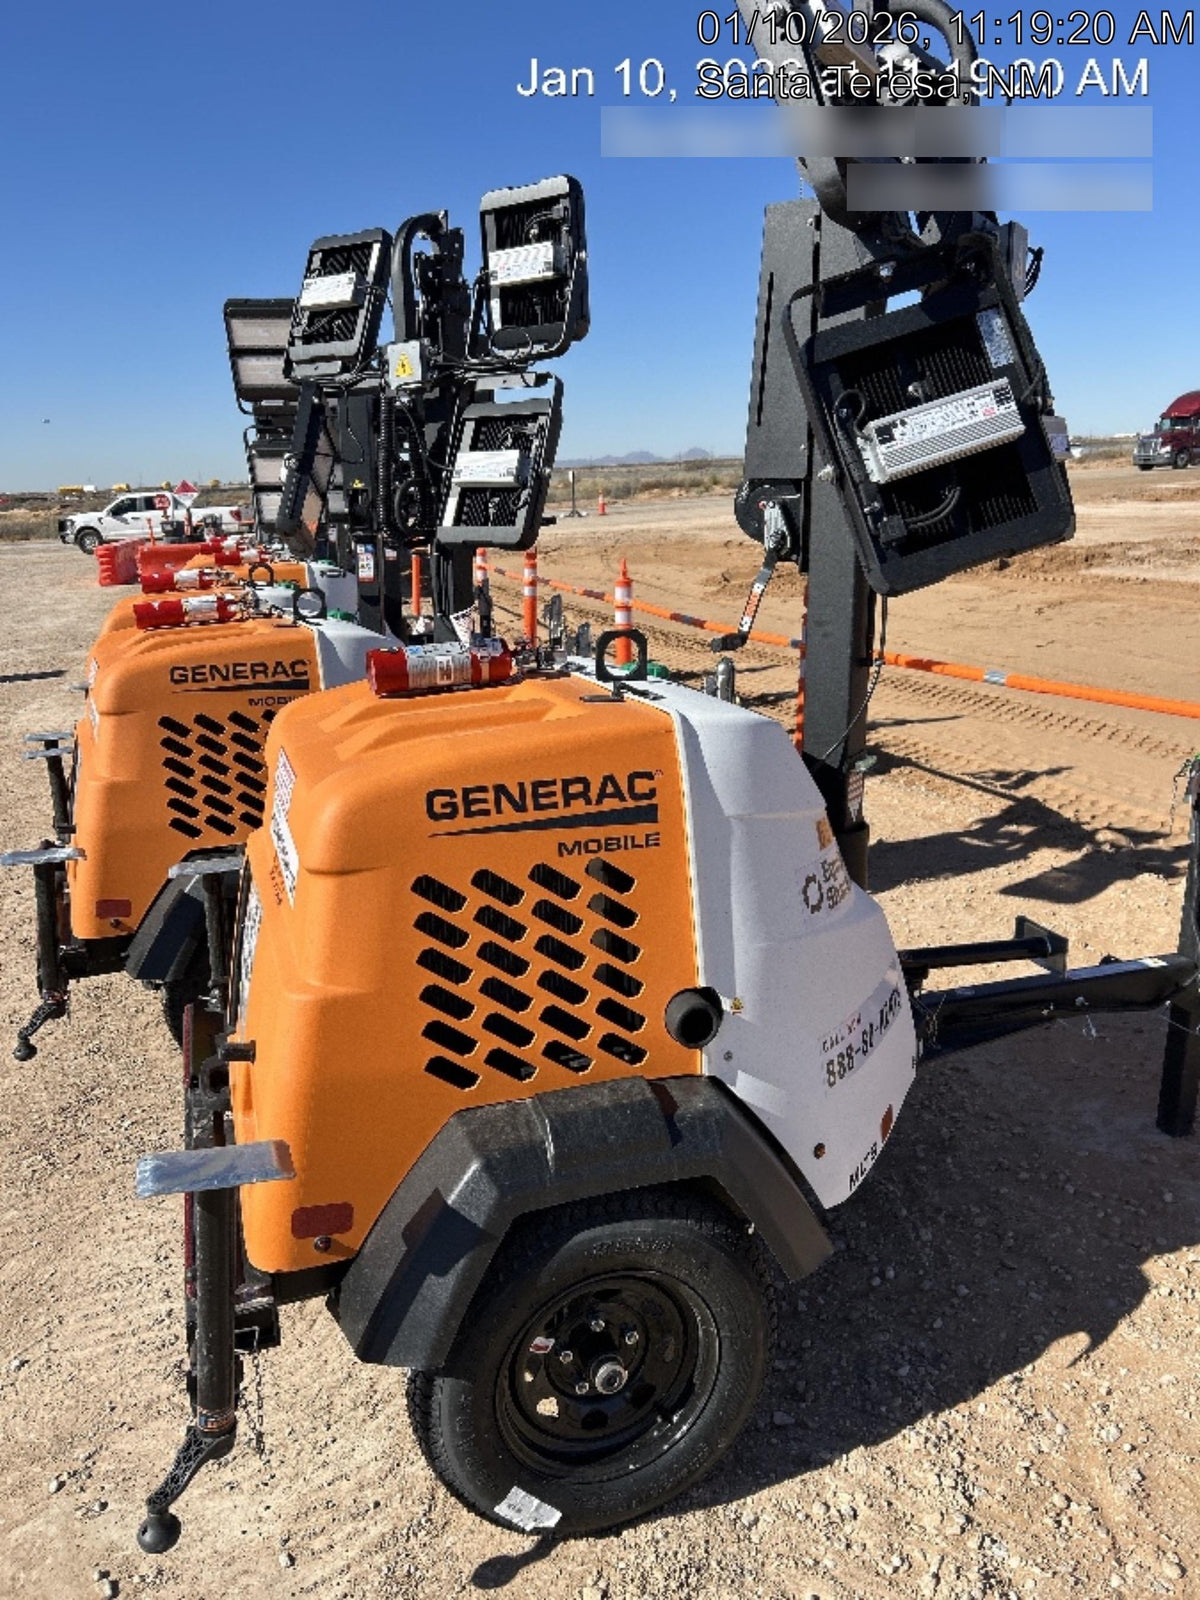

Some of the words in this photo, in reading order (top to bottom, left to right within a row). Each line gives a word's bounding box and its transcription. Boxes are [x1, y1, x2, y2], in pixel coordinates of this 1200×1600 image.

[170, 659, 308, 684] GENERAC
[248, 696, 296, 707] MOBI
[425, 771, 658, 822] GENERAC
[557, 832, 661, 858] MOBILE
